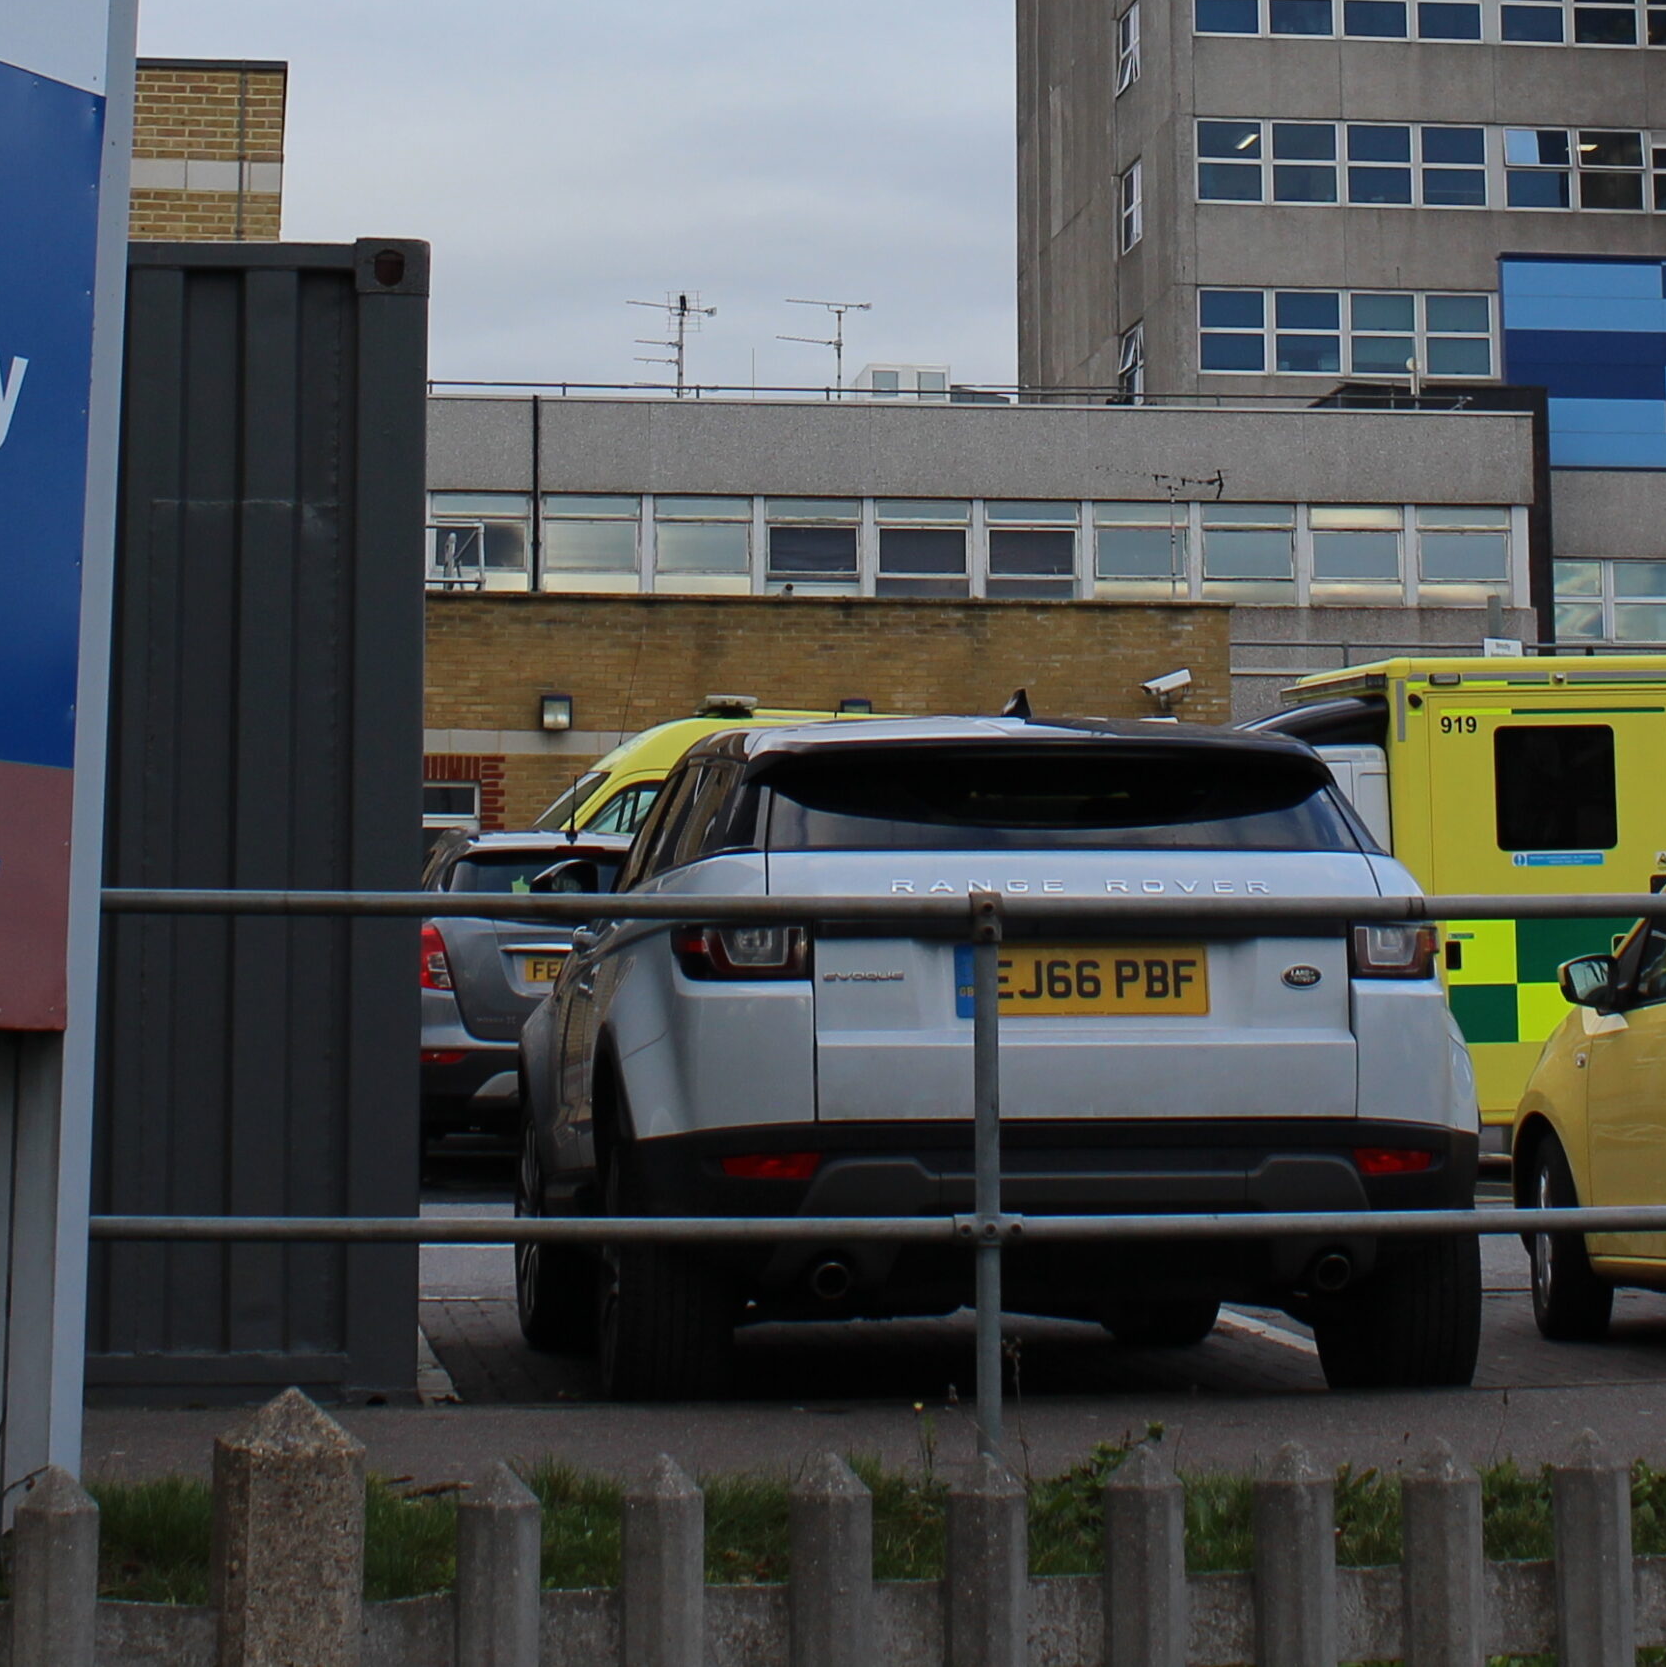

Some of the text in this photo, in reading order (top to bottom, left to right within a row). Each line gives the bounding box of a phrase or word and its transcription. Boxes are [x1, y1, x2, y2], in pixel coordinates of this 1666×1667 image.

[1440, 715, 1478, 734] 919
[890, 878, 1271, 894] RANGE ROVER
[997, 959, 1198, 1000] EJ66 PBF
